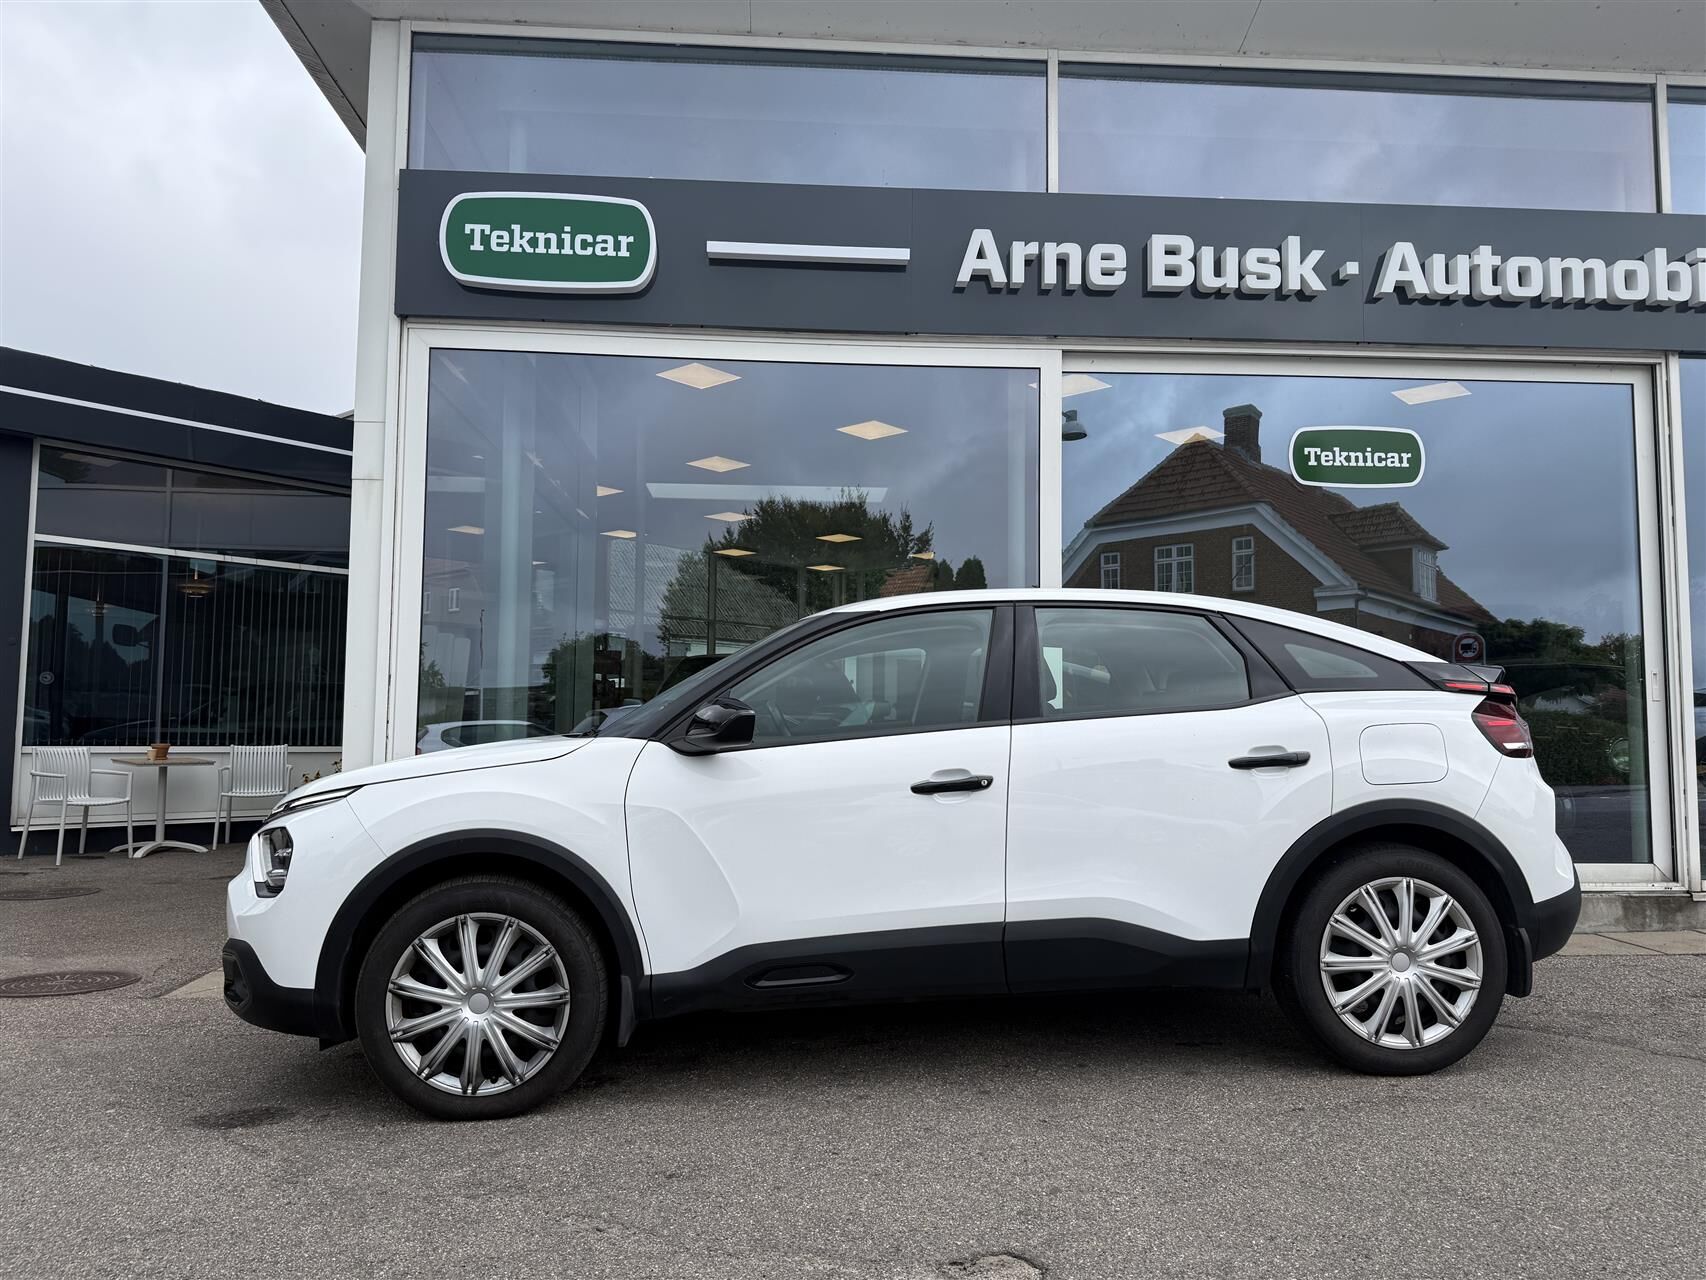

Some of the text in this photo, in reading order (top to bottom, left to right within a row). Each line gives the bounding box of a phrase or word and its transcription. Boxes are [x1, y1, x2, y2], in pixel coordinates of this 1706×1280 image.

[464, 223, 635, 257] Teknicar
[955, 228, 1127, 291] Arne
[1147, 233, 1328, 296] Busk
[1304, 447, 1411, 467] Teknicar
